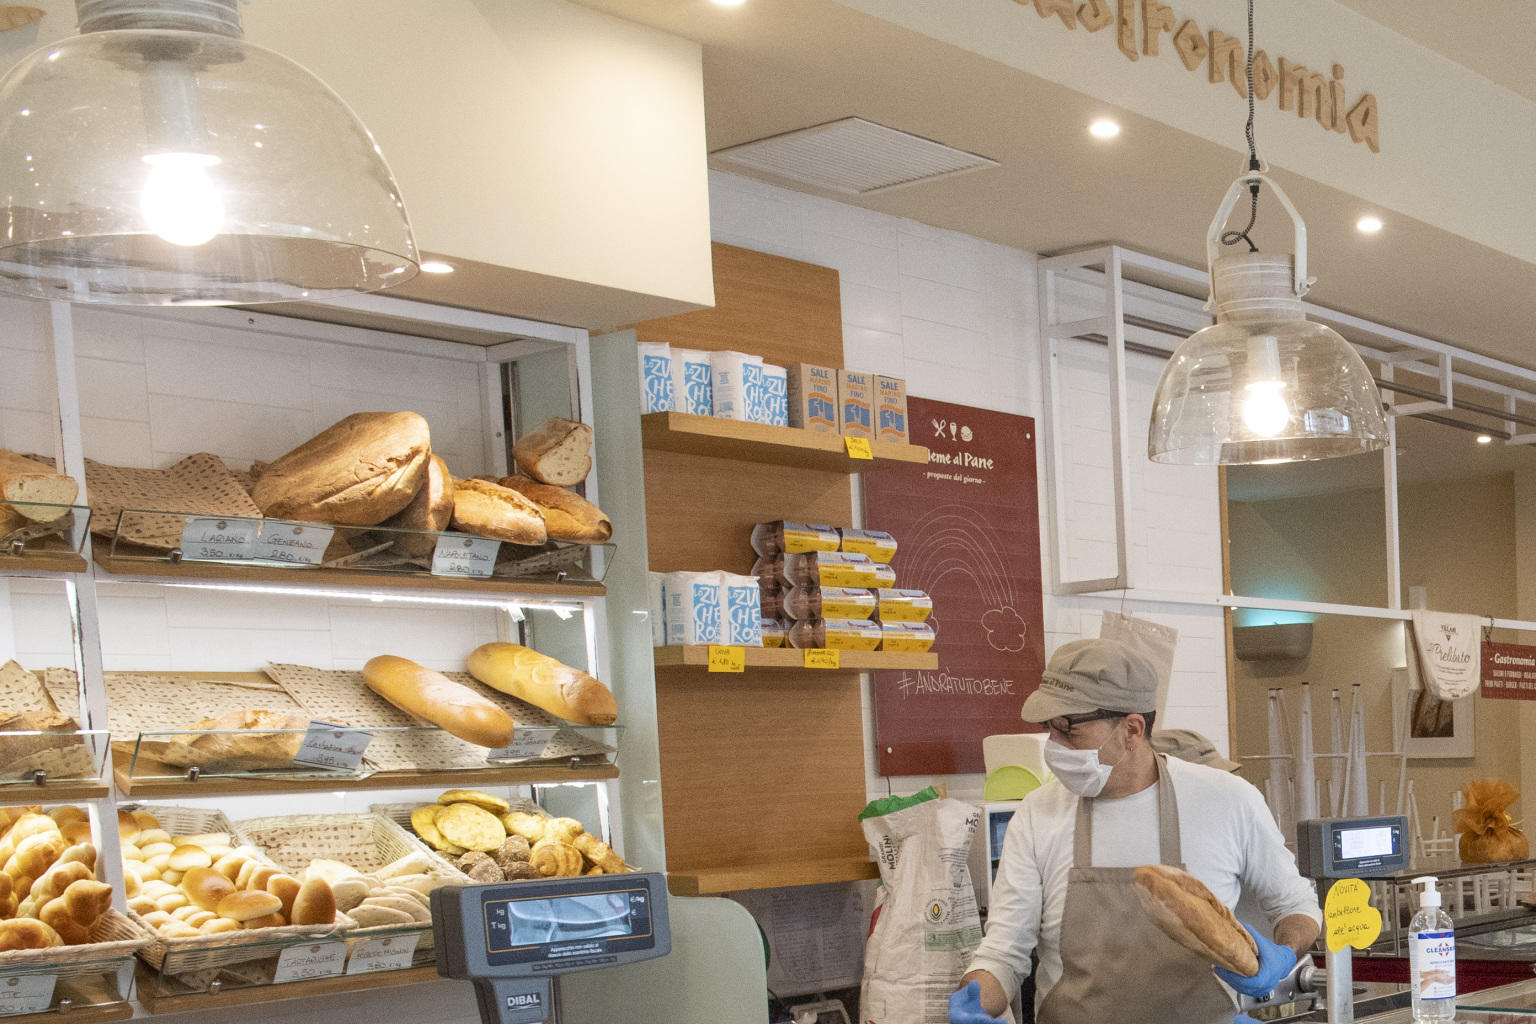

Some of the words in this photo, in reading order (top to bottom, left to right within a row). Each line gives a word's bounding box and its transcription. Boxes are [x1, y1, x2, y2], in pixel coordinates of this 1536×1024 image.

[1012, 0, 1380, 154] stronomia
[810, 367, 829, 378] SALE
[847, 374, 865, 385] SALE
[880, 380, 899, 391] SALE
[953, 452, 962, 466] al
[964, 452, 994, 470] Pane
[1494, 652, 1536, 667] Gastronomia
[883, 834, 897, 870] MOLINI
[507, 994, 540, 1007] DIBAL
